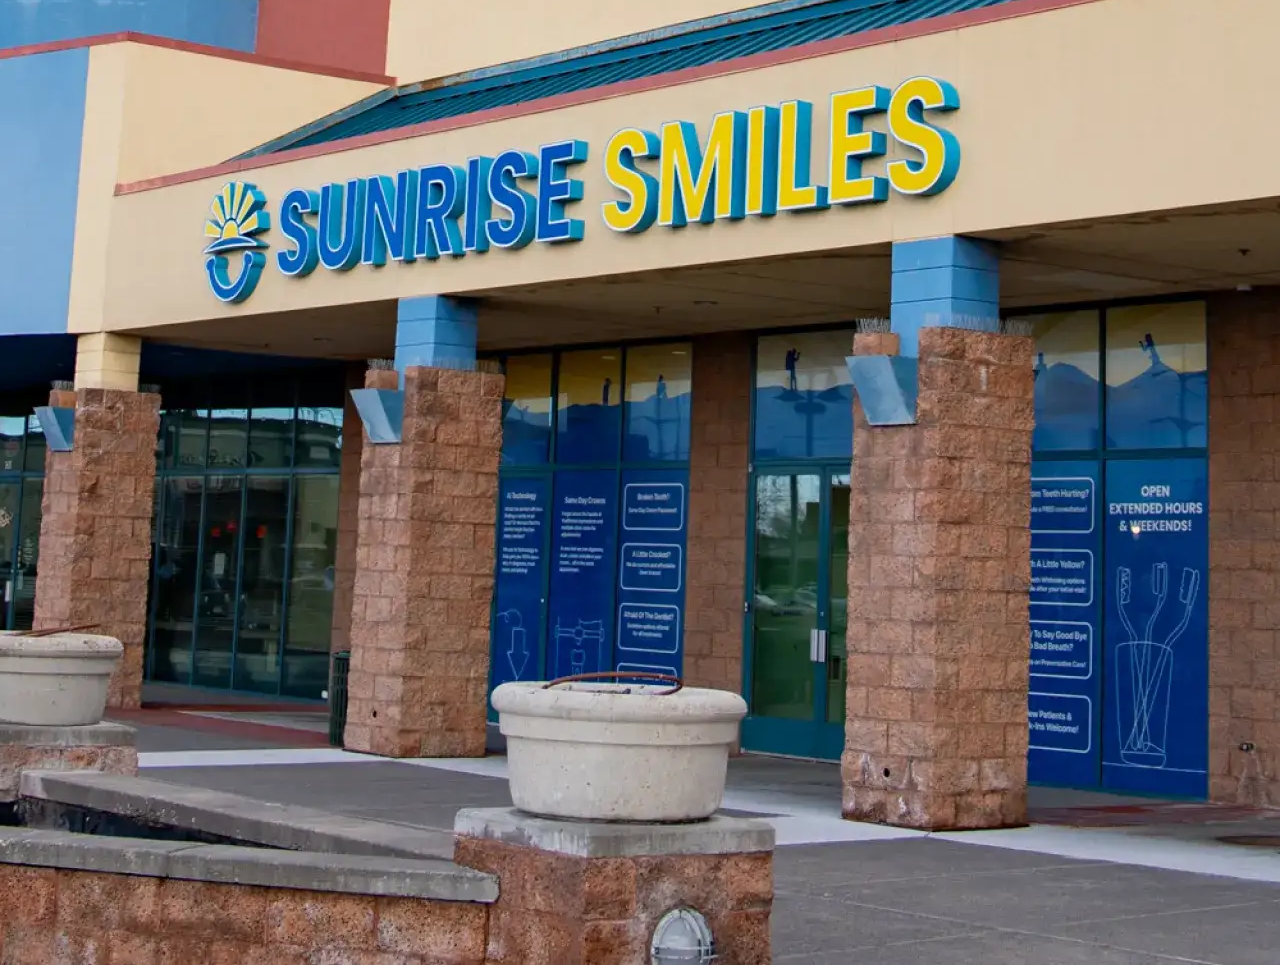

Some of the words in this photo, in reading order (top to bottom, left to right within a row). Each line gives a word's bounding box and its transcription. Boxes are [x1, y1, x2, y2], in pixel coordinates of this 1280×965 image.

[277, 139, 588, 278] SUNRISE
[600, 75, 961, 233] SMILES
[1042, 489, 1060, 498] Teeth
[1061, 489, 1089, 500] Hurting?
[1141, 485, 1170, 497] OPEN
[1109, 502, 1163, 514] EXTENDED
[1164, 502, 1203, 514] HOURS
[1119, 520, 1128, 532] &
[1130, 519, 1192, 532] WEEKENDS!
[1043, 560, 1059, 568] Little
[1060, 560, 1085, 570] Yellow?
[1034, 630, 1042, 638] To
[1043, 630, 1055, 640] Say
[1056, 631, 1074, 639] Good
[1075, 631, 1088, 642] Bye
[1034, 642, 1048, 650] Bad
[1048, 642, 1074, 651] Breath?
[1039, 710, 1065, 721] Patients
